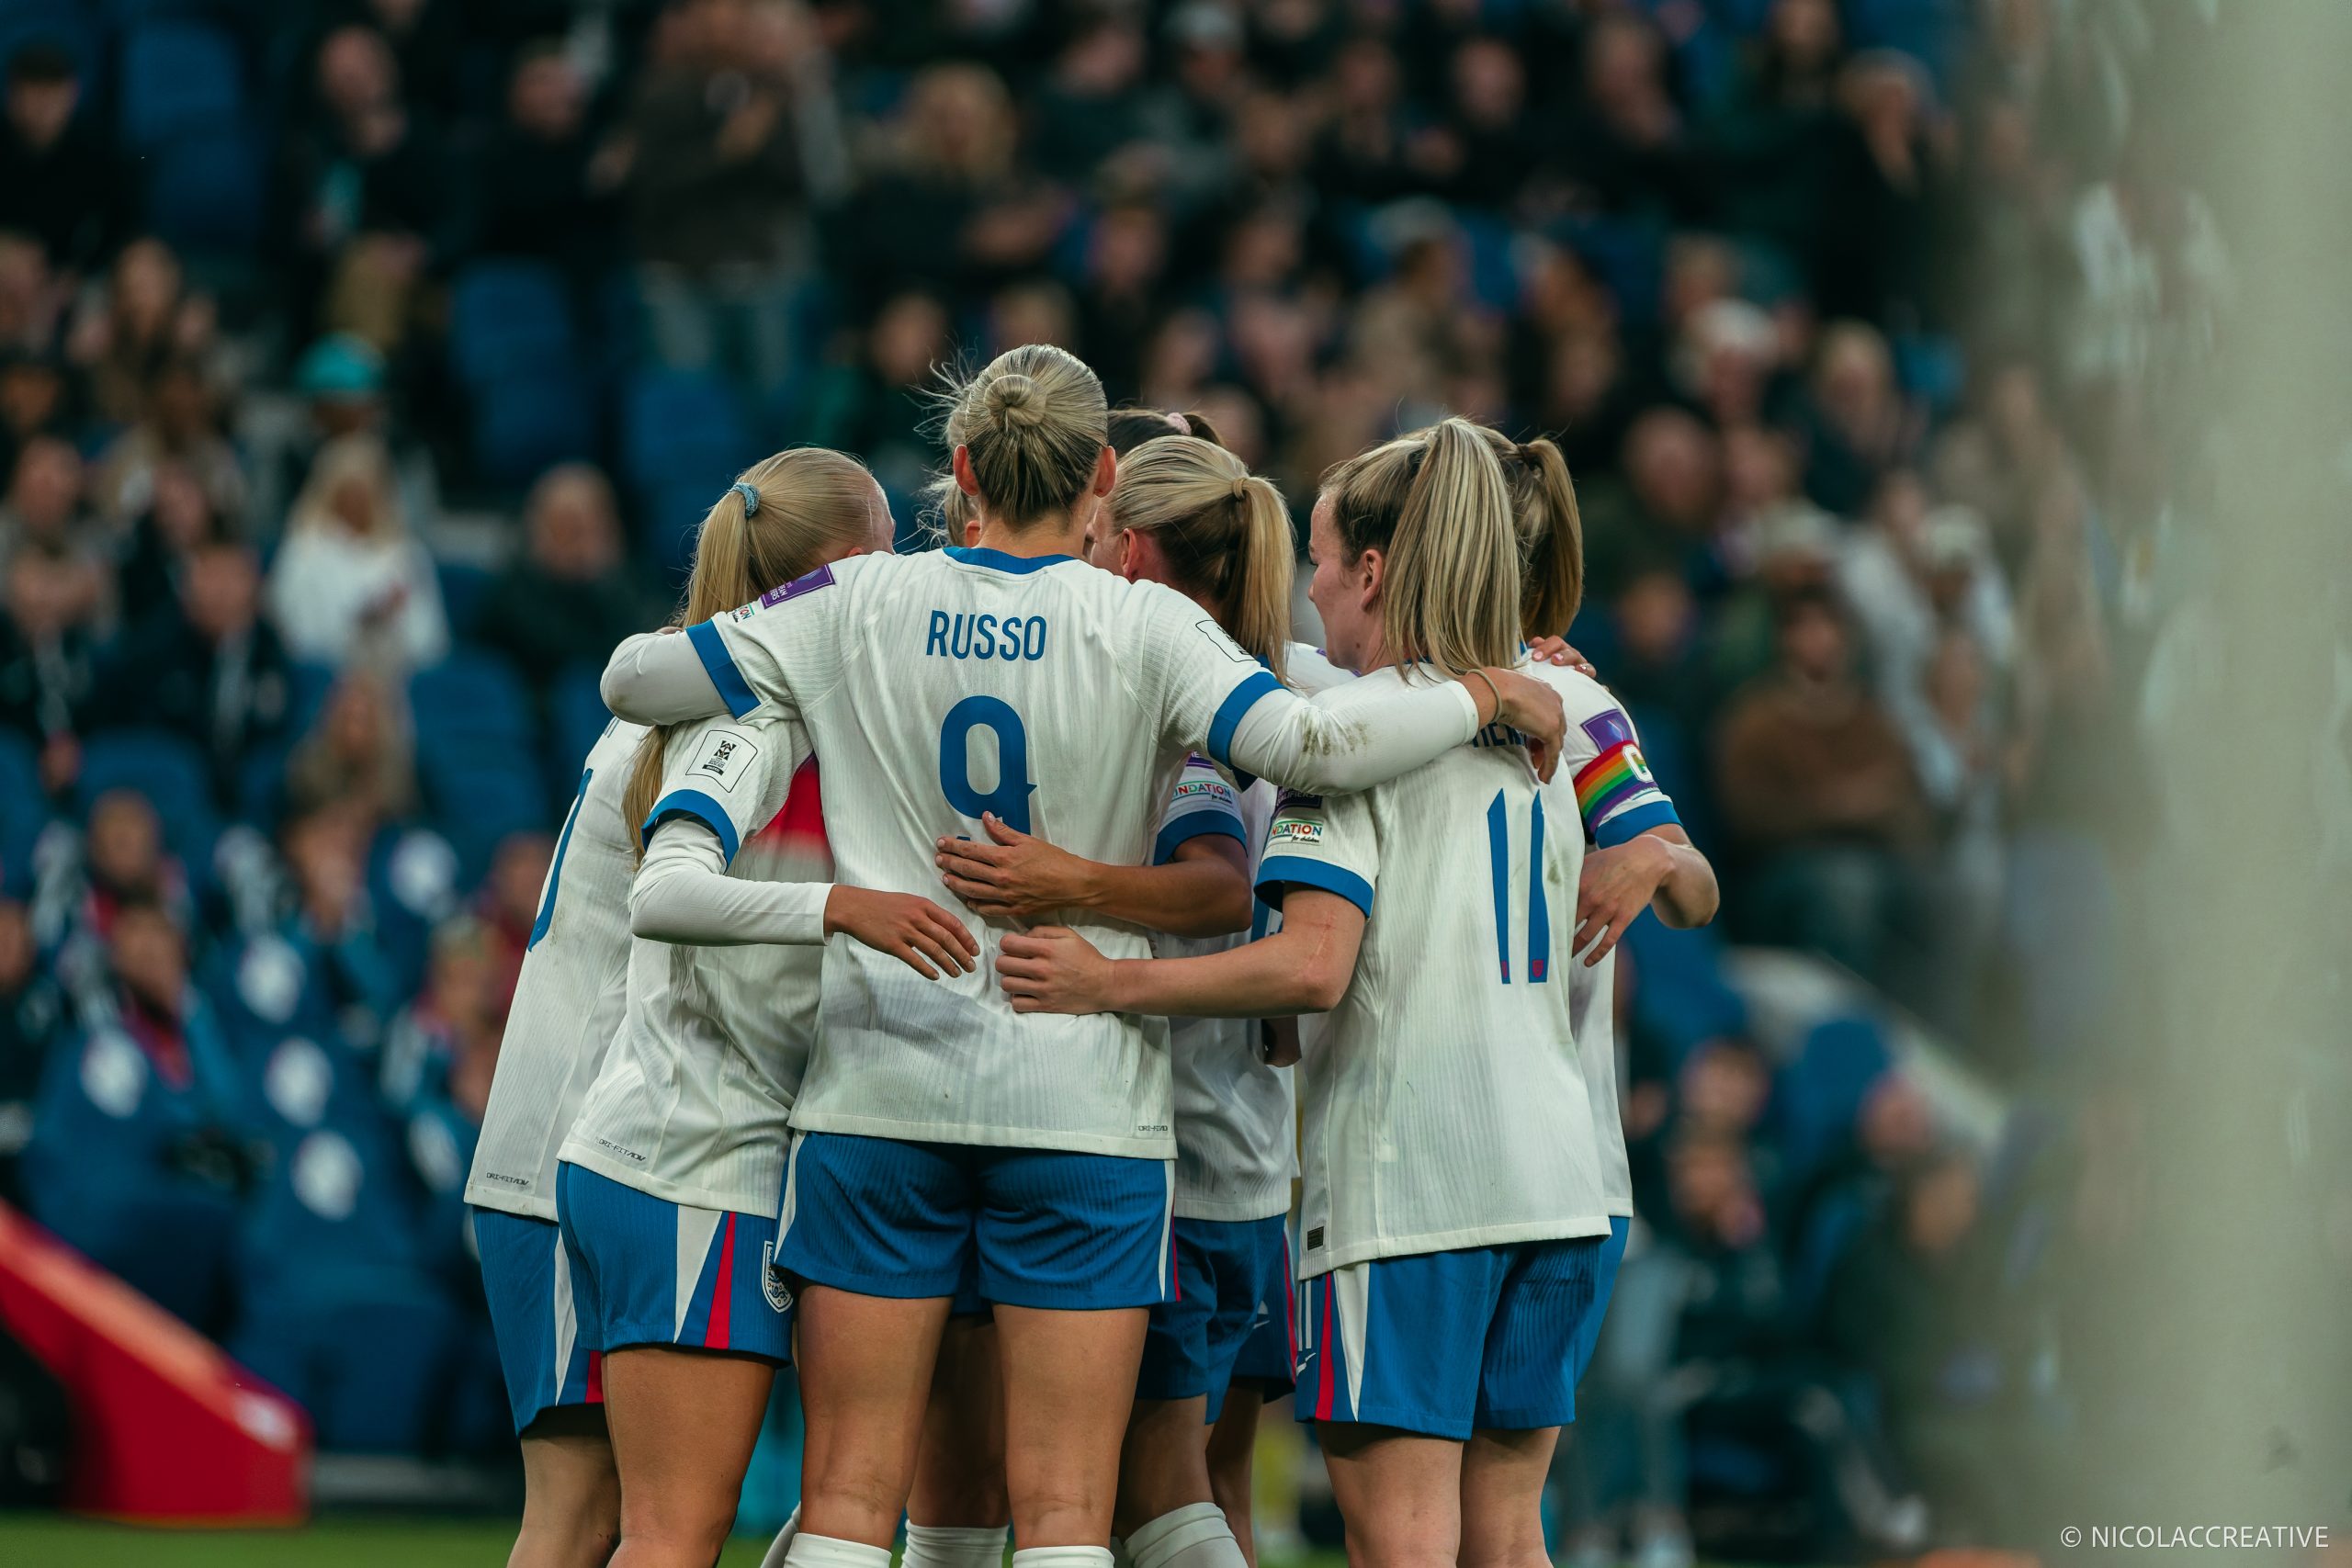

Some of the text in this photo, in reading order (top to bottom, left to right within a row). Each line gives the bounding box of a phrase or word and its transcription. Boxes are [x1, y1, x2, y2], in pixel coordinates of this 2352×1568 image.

[926, 610, 1046, 661] RUSSO
[940, 695, 1037, 840] 9
[1622, 744, 1654, 783] C
[1487, 788, 1550, 984] 11
